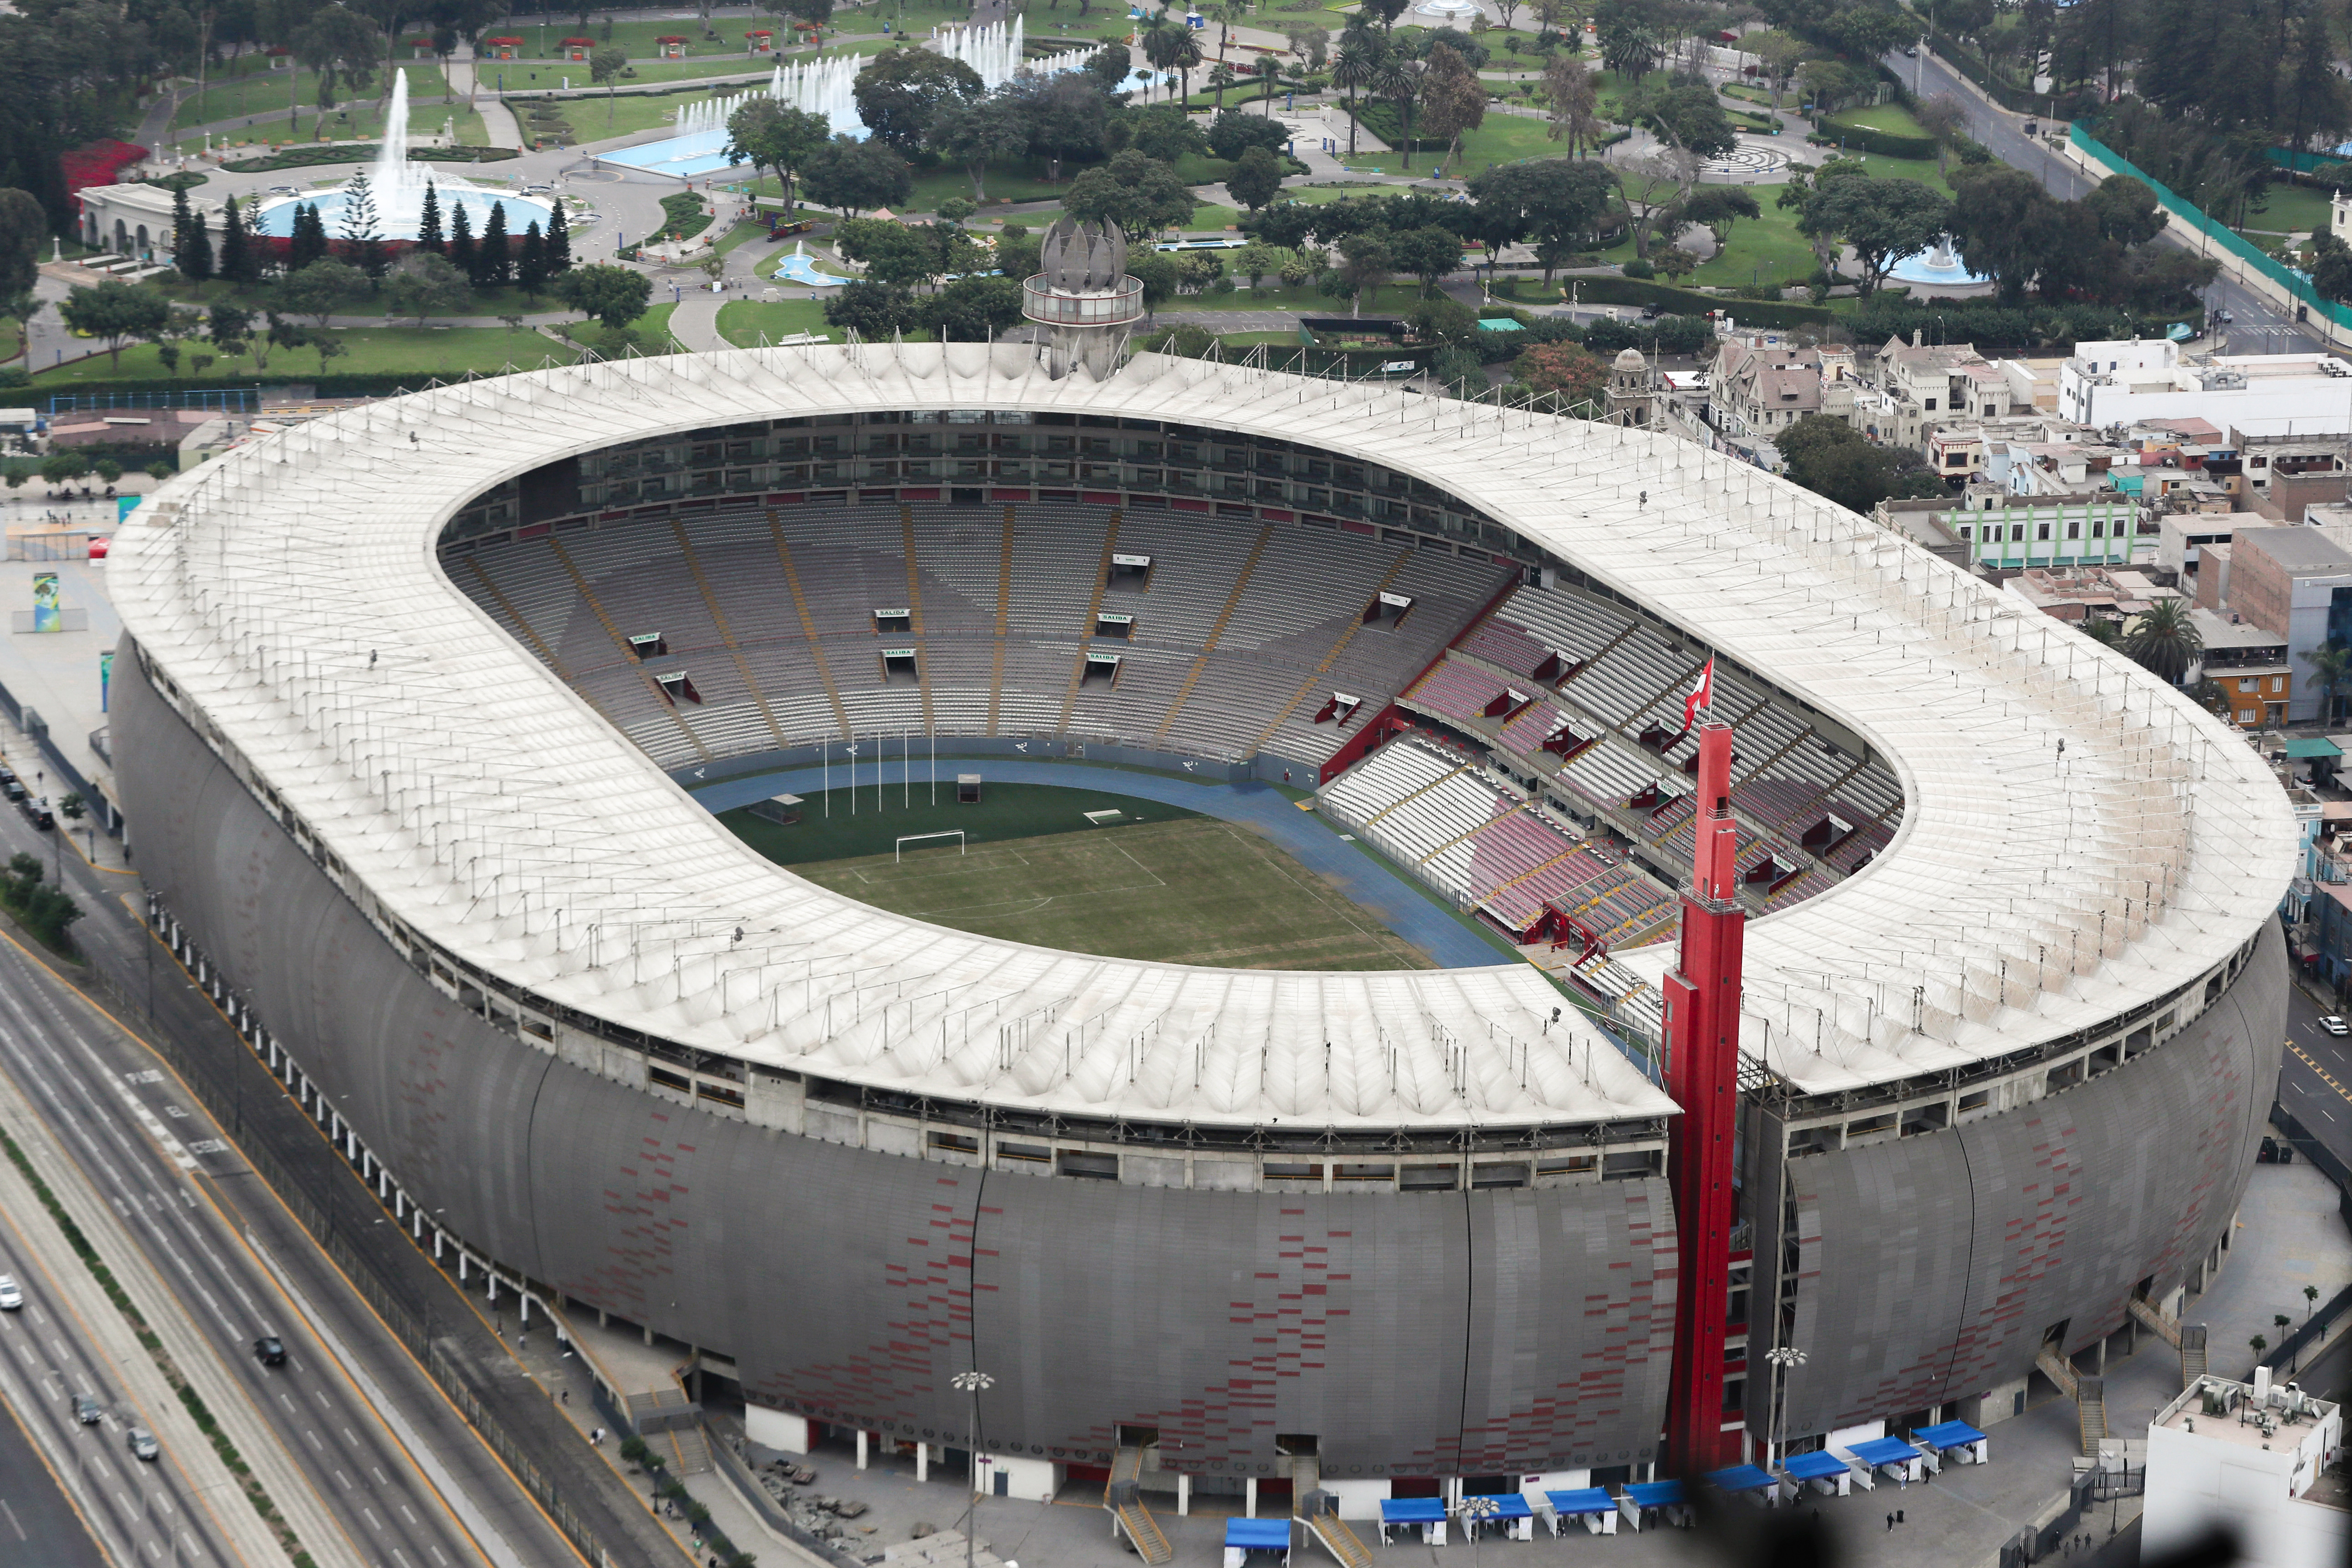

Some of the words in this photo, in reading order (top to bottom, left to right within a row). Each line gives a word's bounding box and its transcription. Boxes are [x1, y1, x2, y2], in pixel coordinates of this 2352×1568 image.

[1663, 721, 1676, 732] SALIDA
[1573, 728, 1585, 739] SALIDA
[1661, 783, 1674, 794] SALIDA
[1776, 856, 1791, 869] SALIDA
